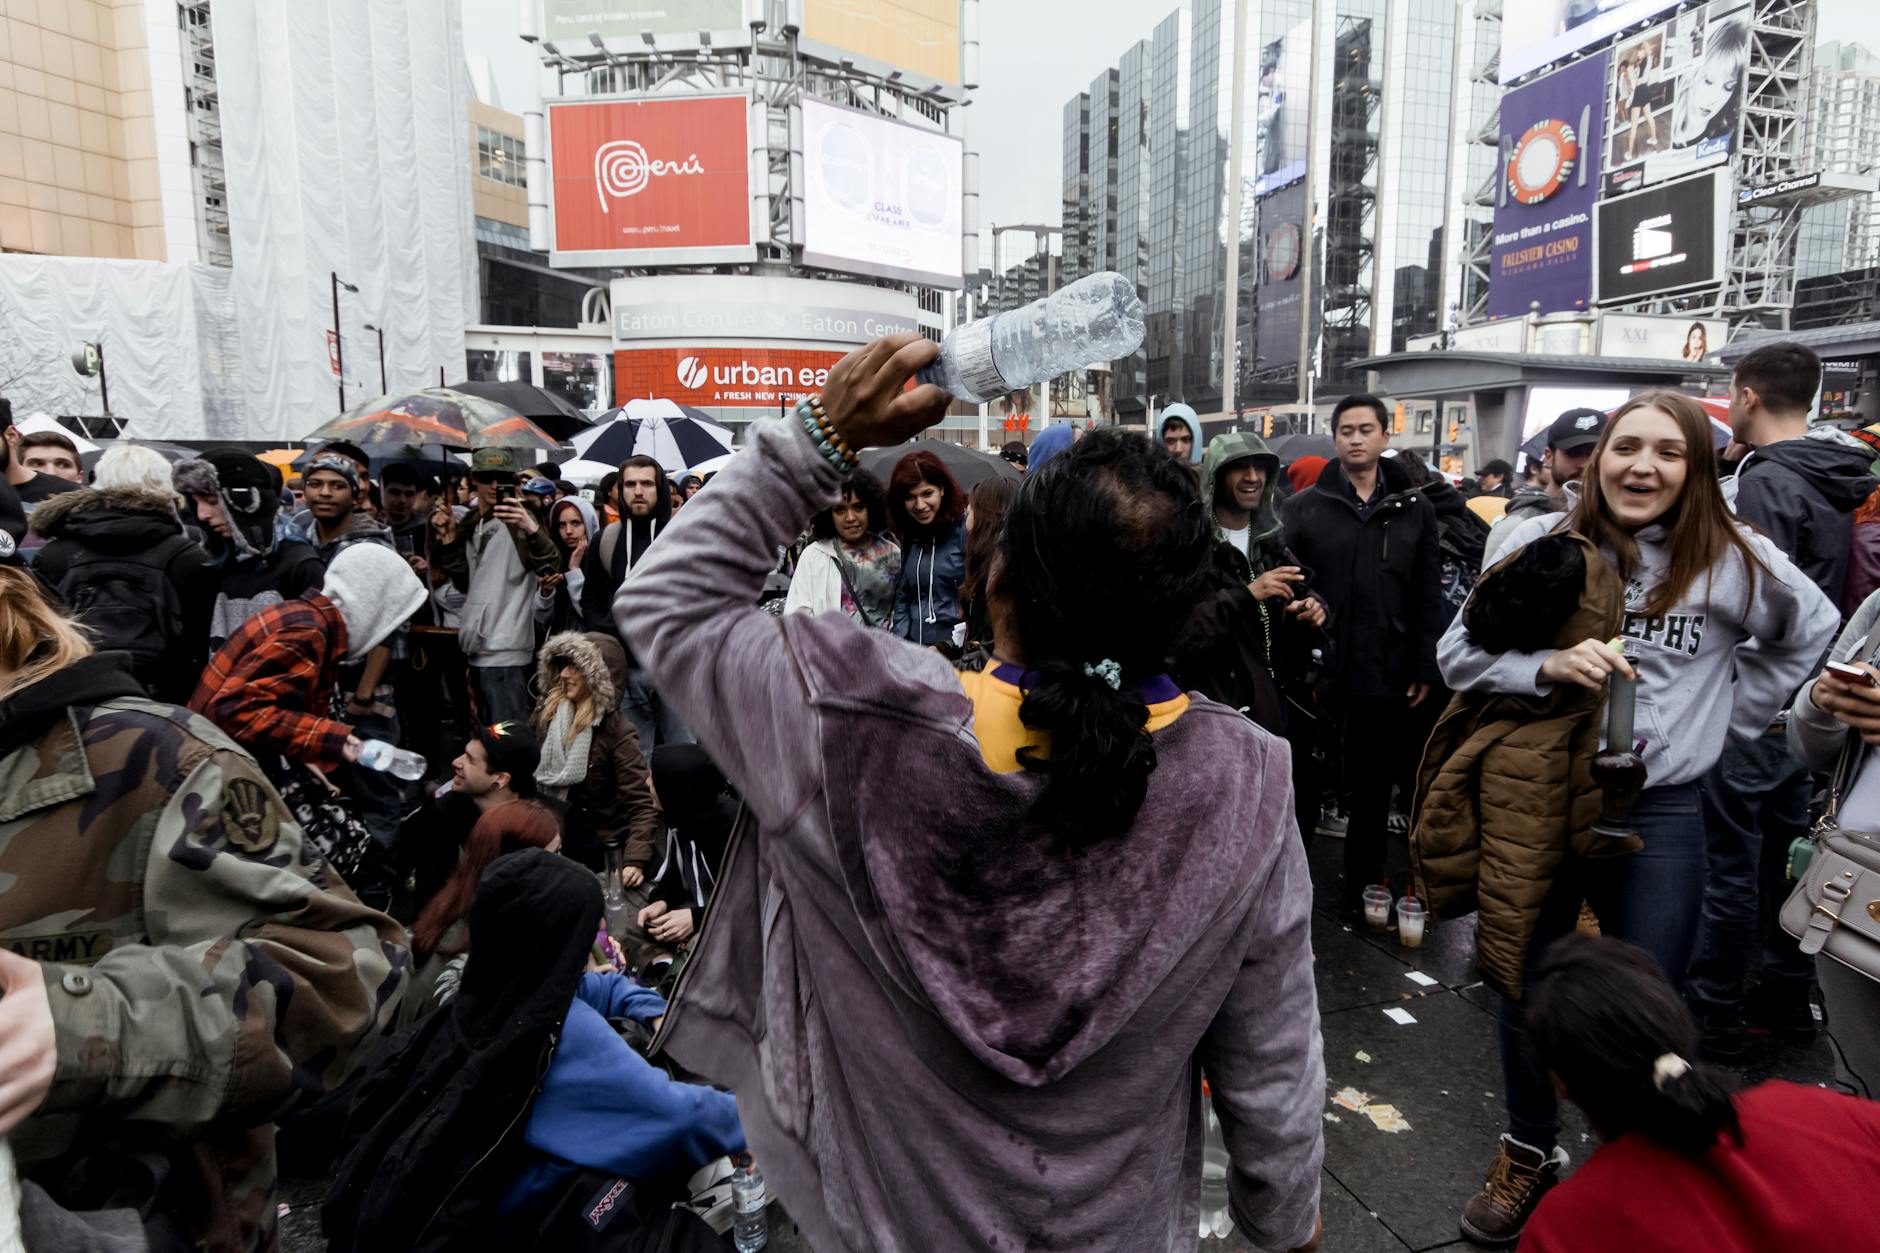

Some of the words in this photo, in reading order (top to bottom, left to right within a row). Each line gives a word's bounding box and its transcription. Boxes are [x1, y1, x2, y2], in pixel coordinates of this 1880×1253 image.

[1697, 139, 1727, 158] Keds
[1752, 186, 1777, 199] Clear
[1777, 174, 1818, 193] Channel
[1495, 231, 1519, 245] More
[1520, 225, 1542, 239] than
[1543, 223, 1551, 232] a
[1552, 213, 1589, 230] casino.
[1545, 236, 1578, 257] CASINO
[620, 312, 676, 331] Eaton
[684, 310, 755, 328] Centre
[803, 311, 857, 334] Eaton
[86, 345, 98, 368] P
[713, 361, 793, 385] urban
[799, 364, 834, 386] ea
[714, 391, 721, 400] A
[724, 391, 751, 400] FRESH
[755, 391, 775, 400] NEW
[1621, 611, 1705, 656] EPH'S
[1623, 642, 1641, 655] GE
[12, 933, 99, 961] ARMY
